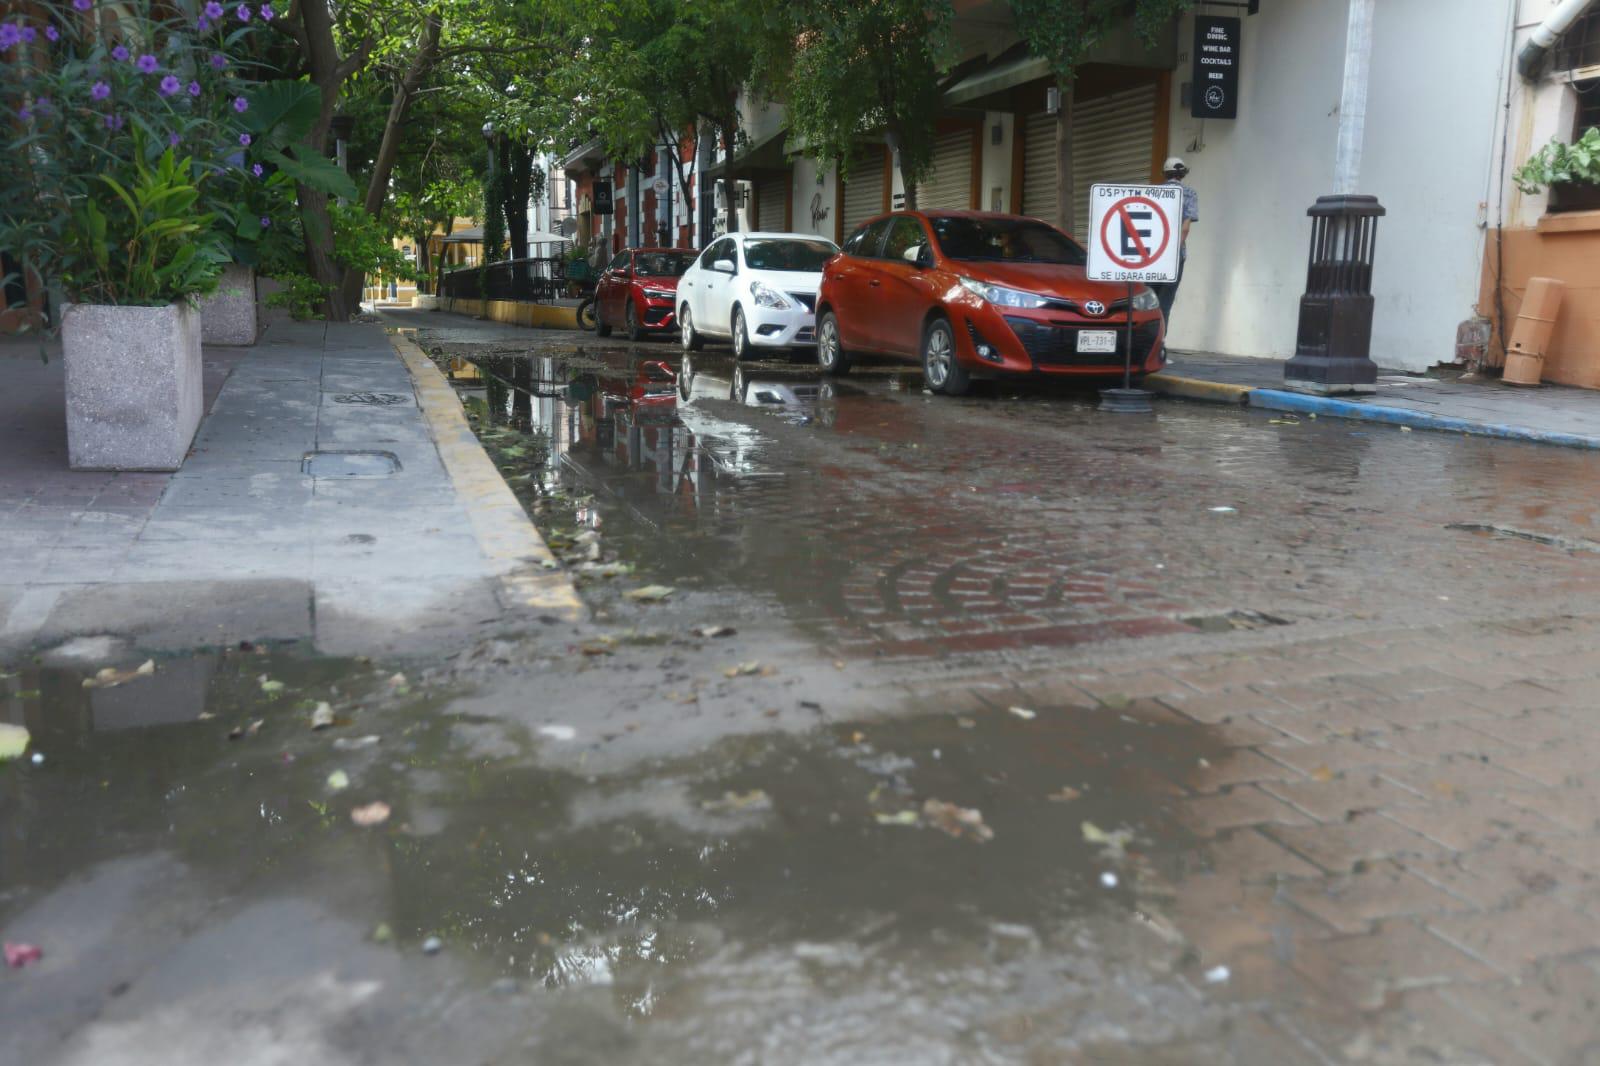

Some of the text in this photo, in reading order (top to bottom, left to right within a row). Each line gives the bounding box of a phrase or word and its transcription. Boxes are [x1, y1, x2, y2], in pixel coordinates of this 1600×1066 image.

[1120, 211, 1152, 256] E
[1100, 272, 1168, 281] SE USARA GRUA
